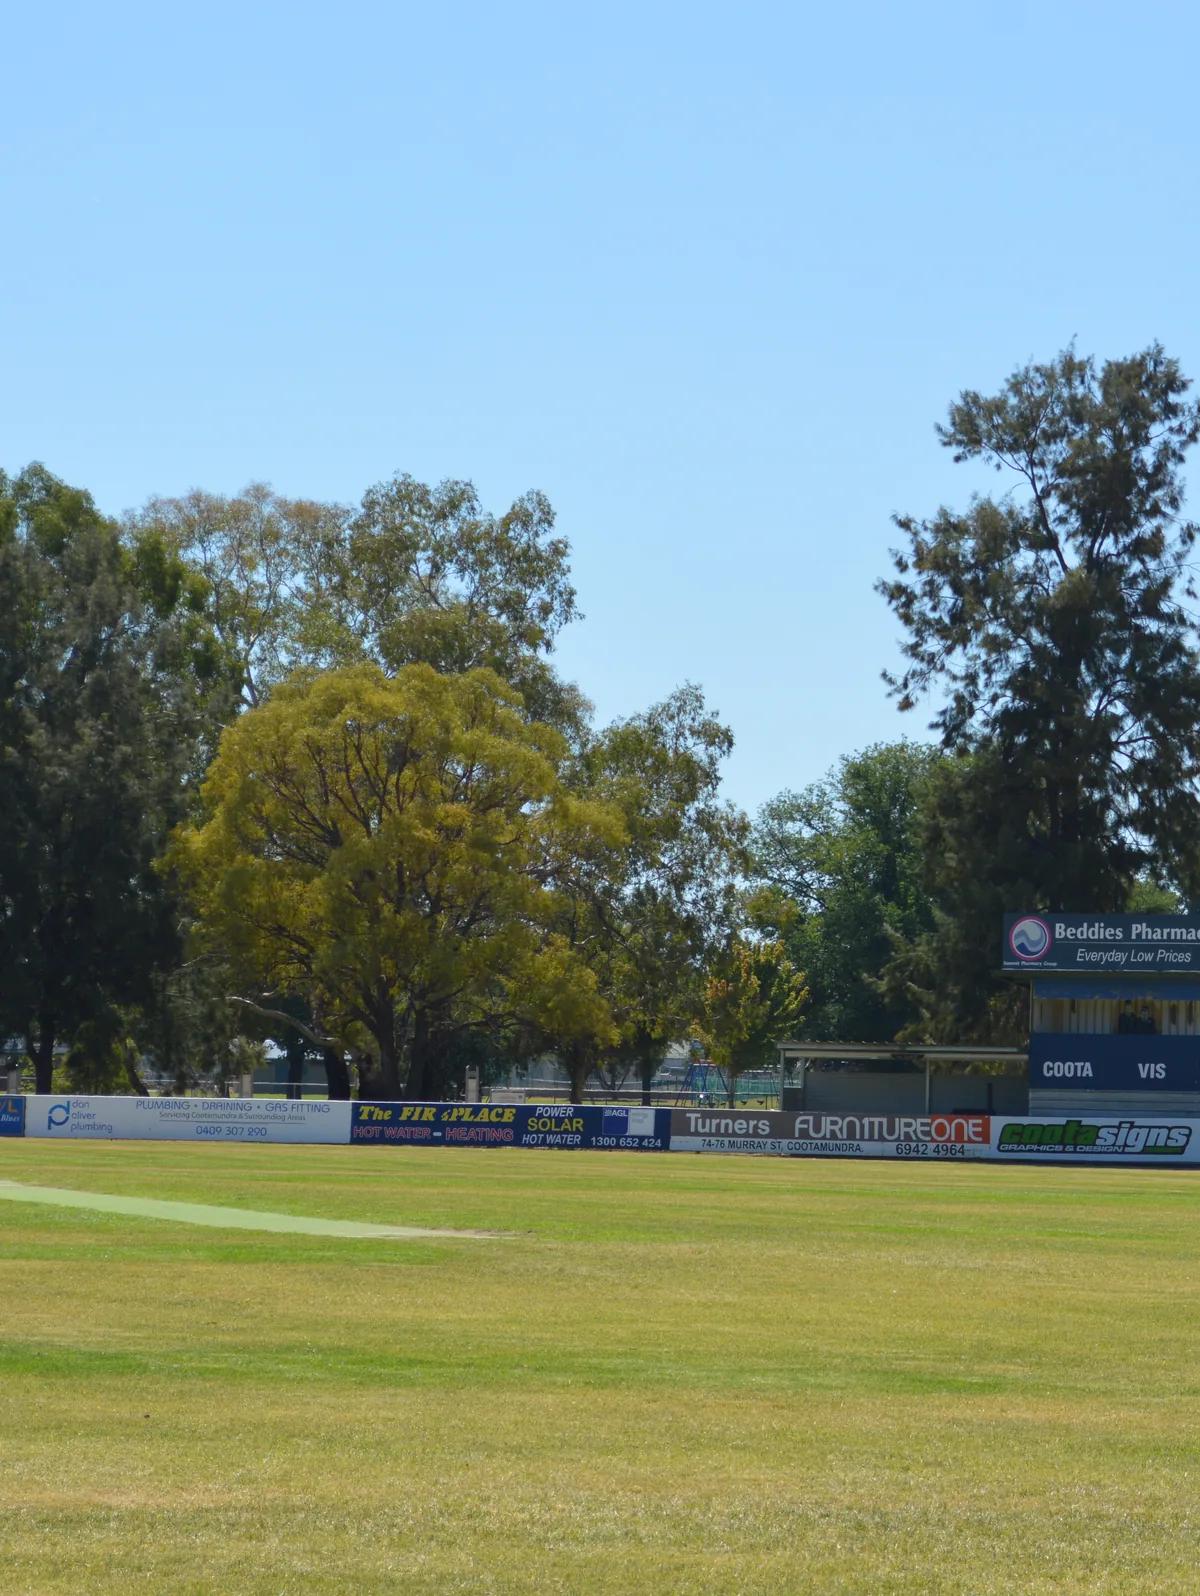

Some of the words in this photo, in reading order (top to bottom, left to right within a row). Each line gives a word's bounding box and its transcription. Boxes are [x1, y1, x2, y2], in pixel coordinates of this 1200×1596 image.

[1055, 922, 1123, 939] Beddies
[1077, 949, 1128, 964] Everyday
[1131, 950, 1155, 961] Low
[1157, 950, 1191, 963] Prices
[1043, 1061, 1093, 1077] COOTA
[1138, 1063, 1166, 1079] VIS
[136, 1100, 190, 1110] PLUMBING
[202, 1101, 252, 1111] DRAINING
[265, 1102, 288, 1112] GAS
[291, 1103, 330, 1113] FITTING
[359, 1105, 392, 1120] The
[535, 1106, 574, 1117] POWER
[611, 1109, 628, 1117] AGL
[71, 1122, 113, 1134] plumbing
[528, 1118, 584, 1132] SOLAR
[686, 1112, 770, 1135] Turners
[196, 1126, 222, 1135] 0409
[225, 1126, 244, 1136] 307
[247, 1127, 267, 1137] 290
[353, 1126, 382, 1138] HOT
[384, 1126, 431, 1139] WATER
[445, 1127, 514, 1141] HEATING
[1000, 1120, 1192, 1153] cootasigns
[522, 1134, 543, 1144] HOT
[546, 1134, 581, 1145] WATER
[591, 1137, 616, 1146] 1300
[619, 1137, 639, 1147] 652
[642, 1138, 661, 1147] 424
[701, 1139, 725, 1149] 74-76
[727, 1140, 769, 1150] MURRAY
[895, 1143, 928, 1156] 6942
[932, 1144, 965, 1156] 4964
[1000, 1143, 1063, 1151] GRAPHICS
[1076, 1145, 1123, 1153] DESIGN
